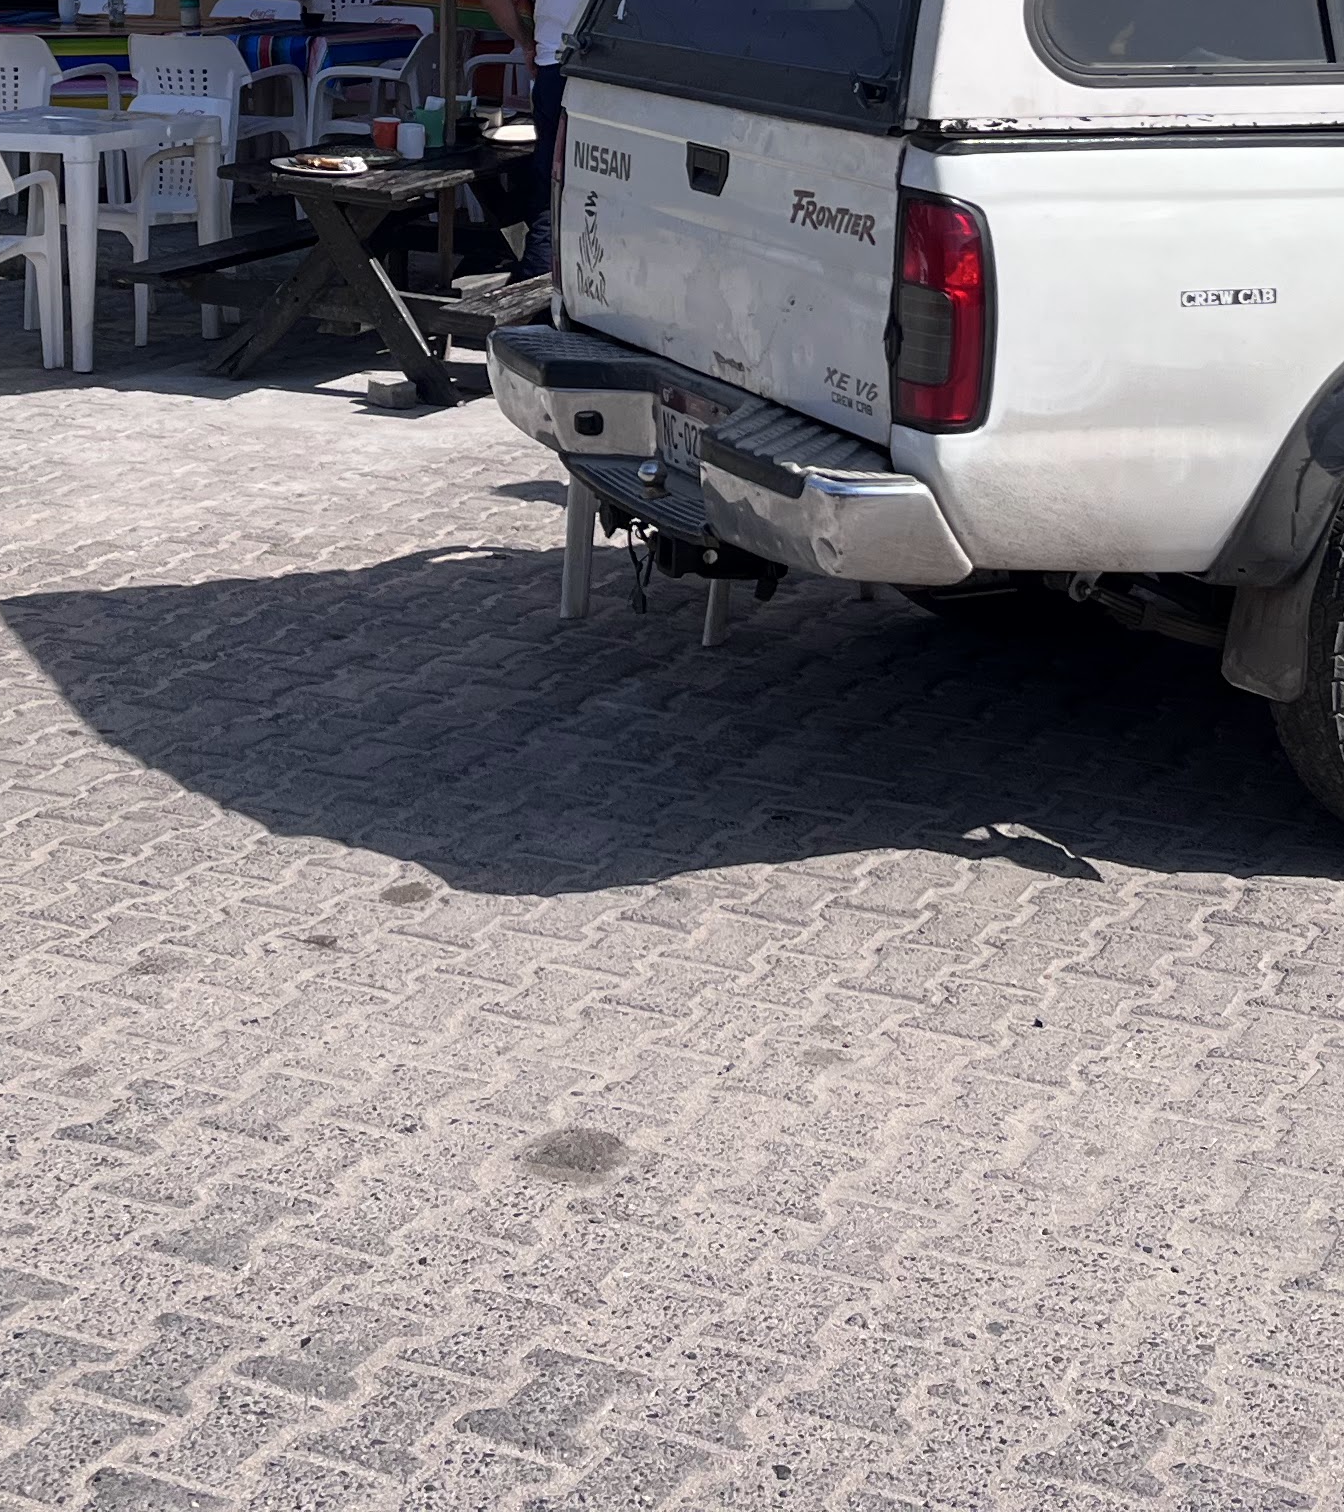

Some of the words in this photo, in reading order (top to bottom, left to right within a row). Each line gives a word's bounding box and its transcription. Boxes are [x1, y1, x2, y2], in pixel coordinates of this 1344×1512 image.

[574, 140, 631, 182] NISSAN
[576, 262, 610, 308] DAKAR
[1181, 290, 1234, 307] CREW
[1238, 288, 1276, 305] CAB
[824, 366, 851, 392] XE
[856, 378, 878, 402] V6
[662, 410, 703, 460] NC-02
